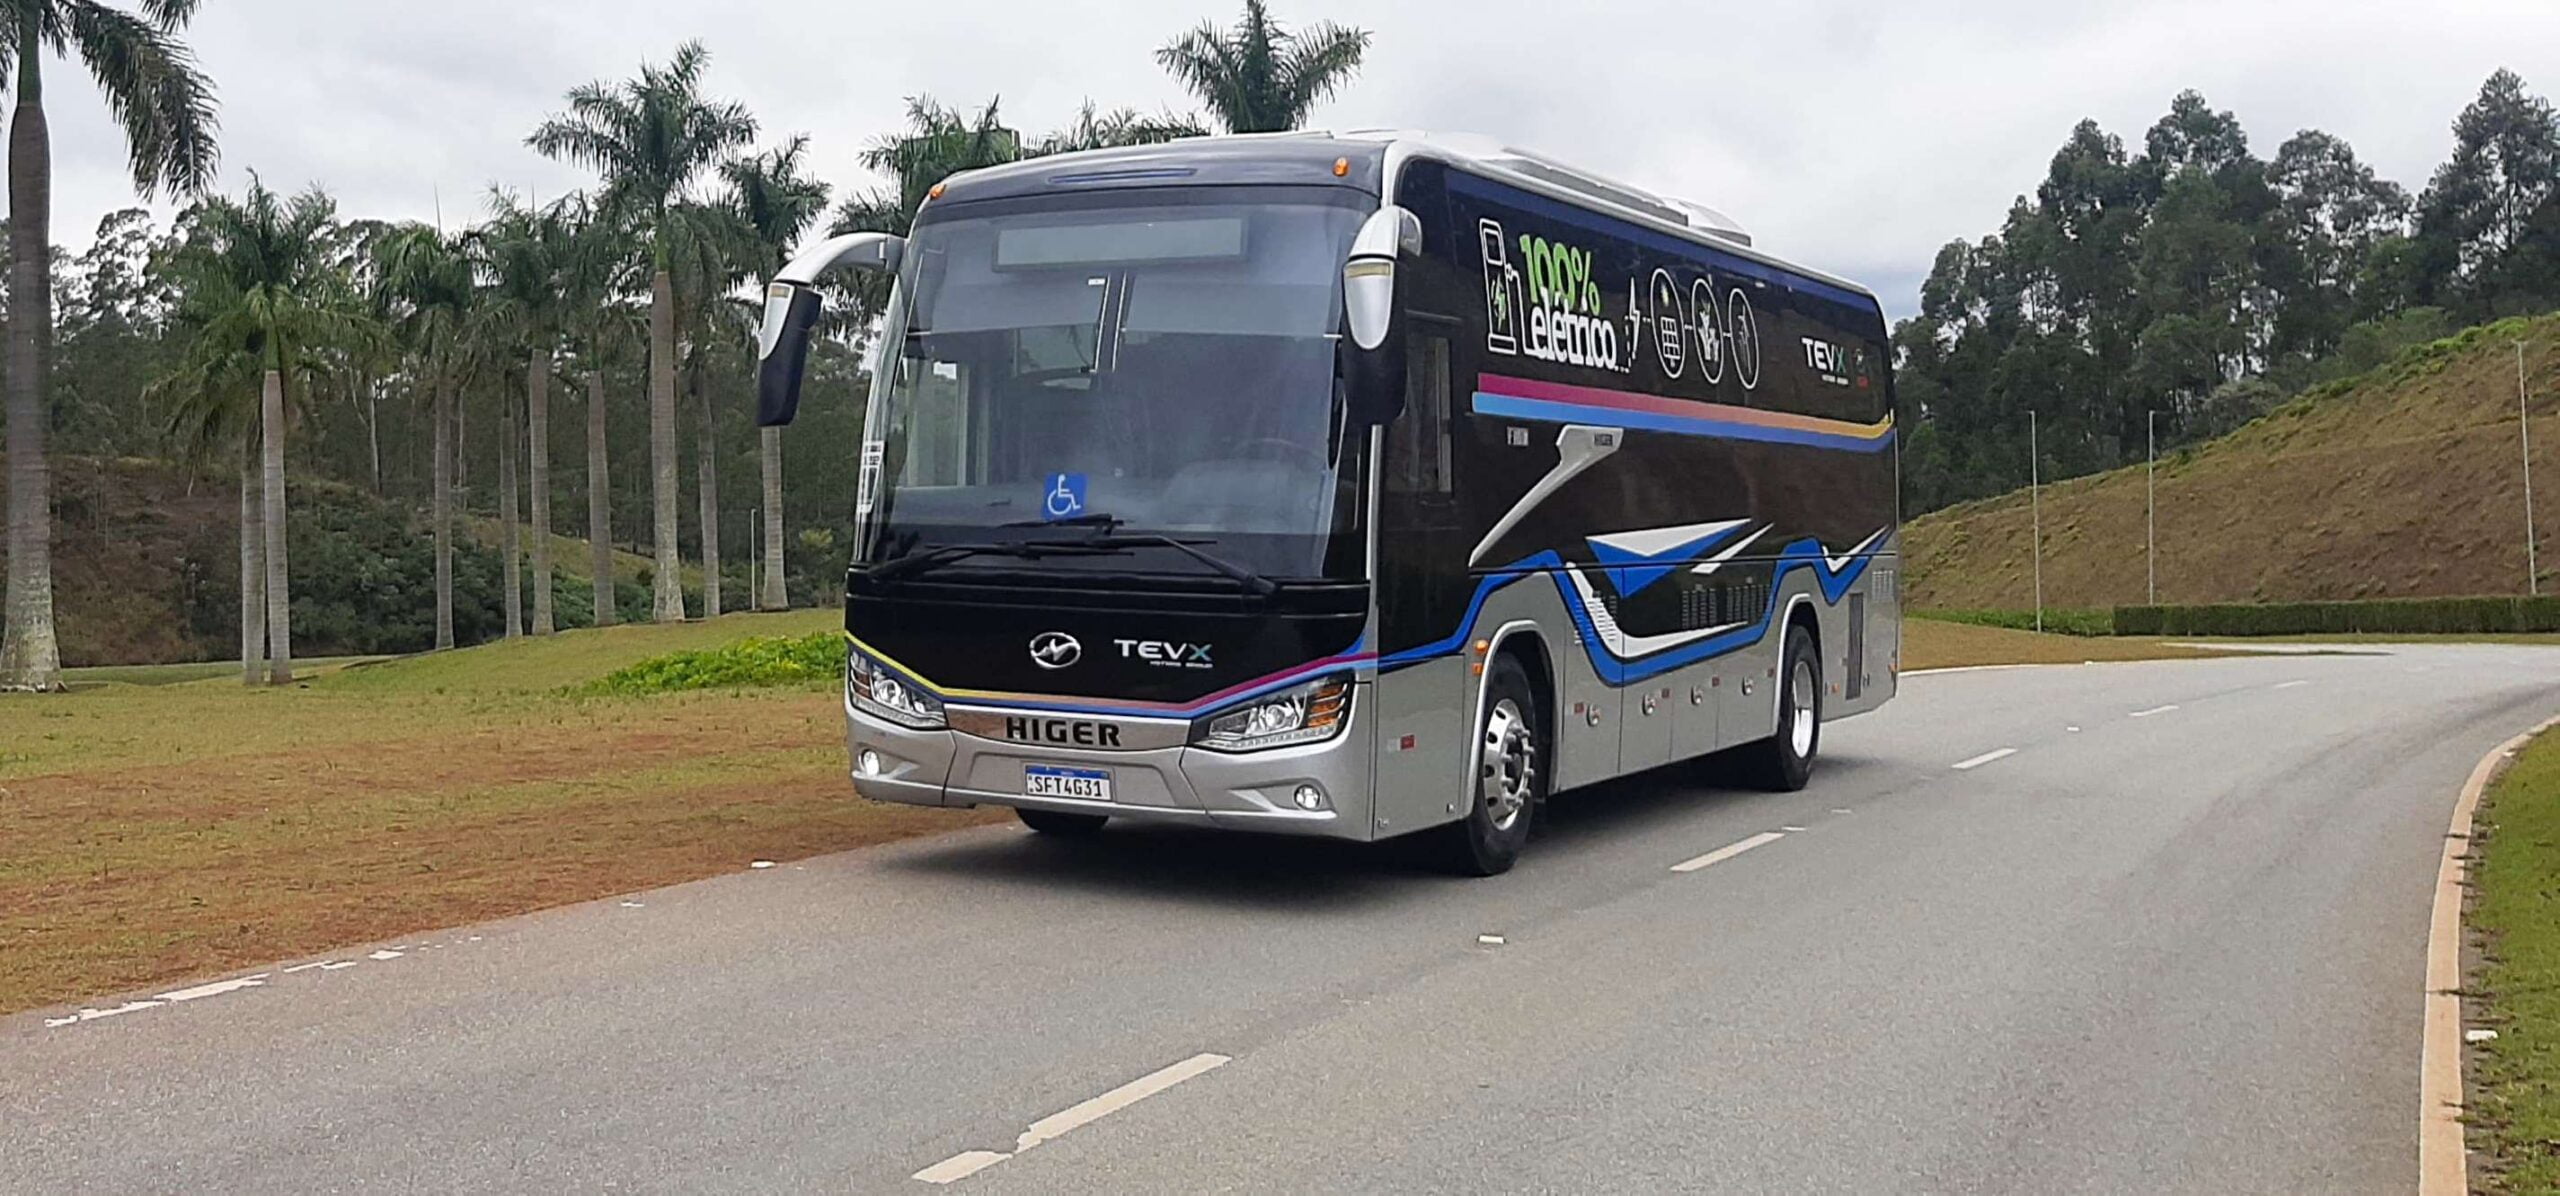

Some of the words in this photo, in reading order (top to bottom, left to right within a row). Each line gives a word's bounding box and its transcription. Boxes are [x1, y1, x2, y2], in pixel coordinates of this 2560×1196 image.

[1520, 234, 1600, 316] 100%
[1801, 337, 1847, 373] TEVX
[1114, 639, 1213, 661] TEVX
[1006, 716, 1121, 747] HIGER
[1034, 776, 1102, 797] SFT4G31
